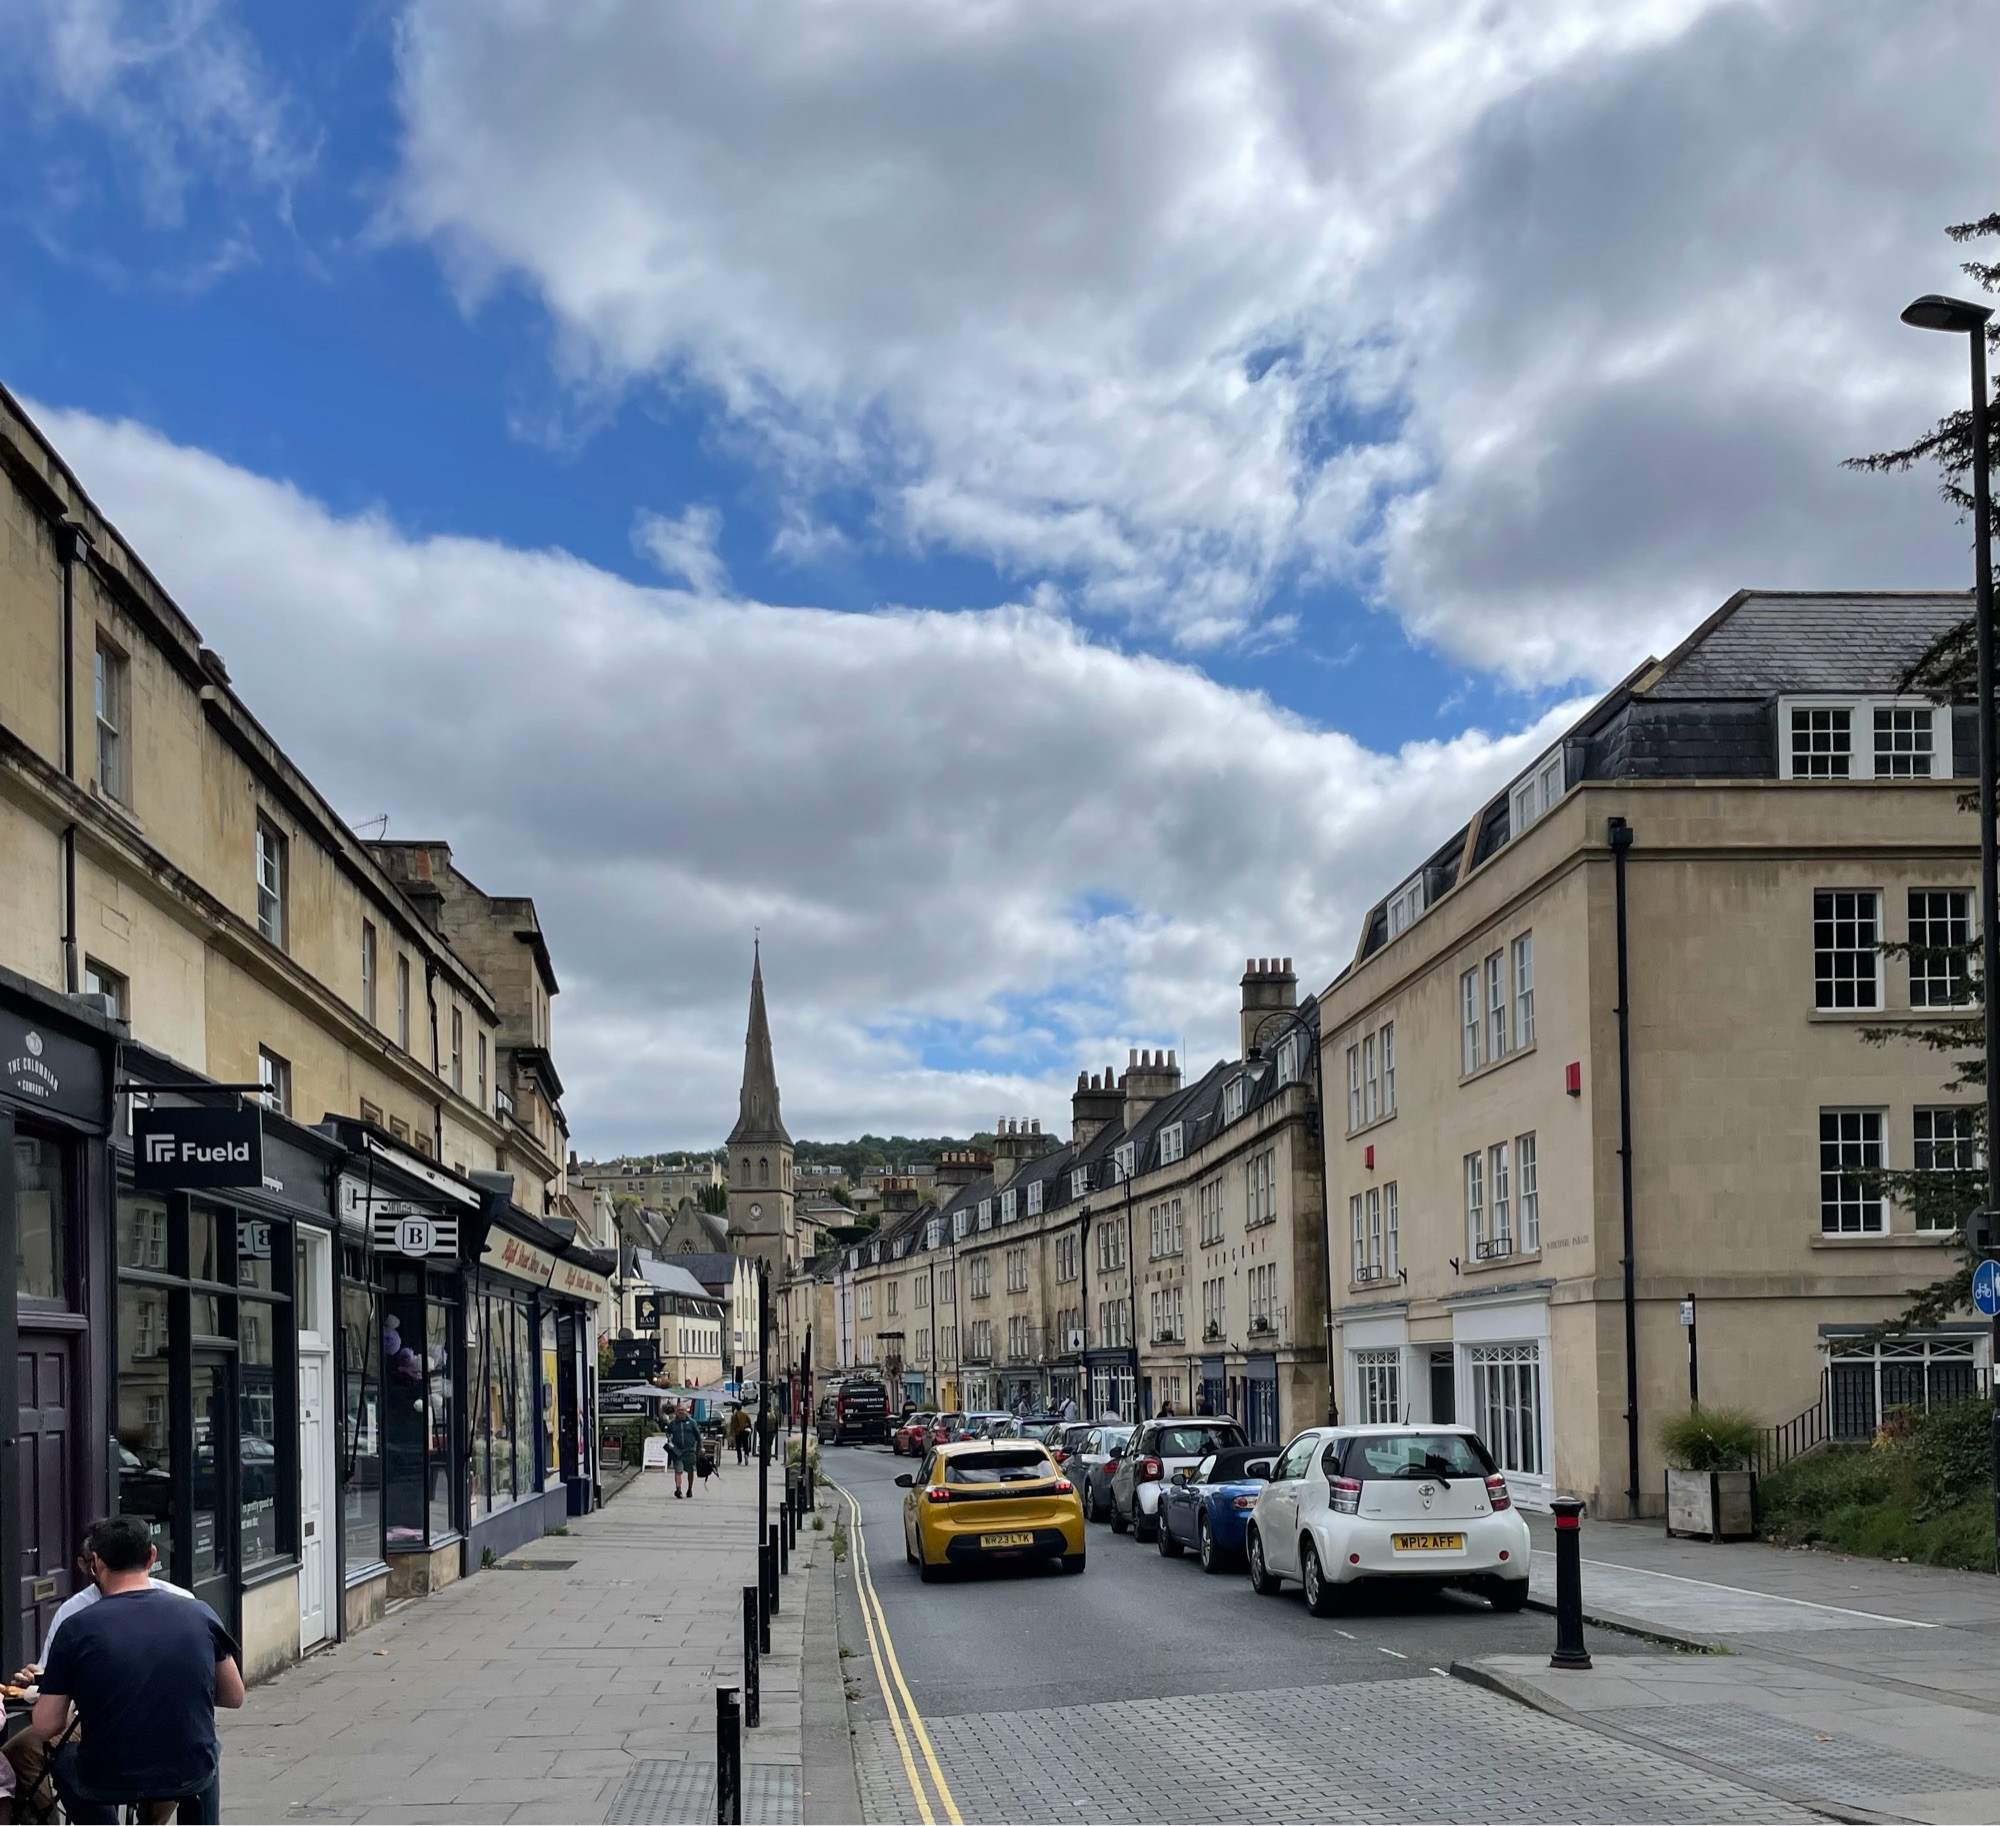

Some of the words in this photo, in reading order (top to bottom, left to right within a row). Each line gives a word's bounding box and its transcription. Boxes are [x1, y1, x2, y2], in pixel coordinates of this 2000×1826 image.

[8, 1058, 21, 1075] THE
[23, 1057, 59, 1092] COLOMBIAN
[22, 1079, 44, 1097] COMPANY
[182, 1141, 250, 1162] Fueld
[409, 1227, 423, 1244] B
[640, 1316, 655, 1324] RAM
[1401, 1537, 1430, 1549] WP12
[1432, 1536, 1455, 1548] AFF
